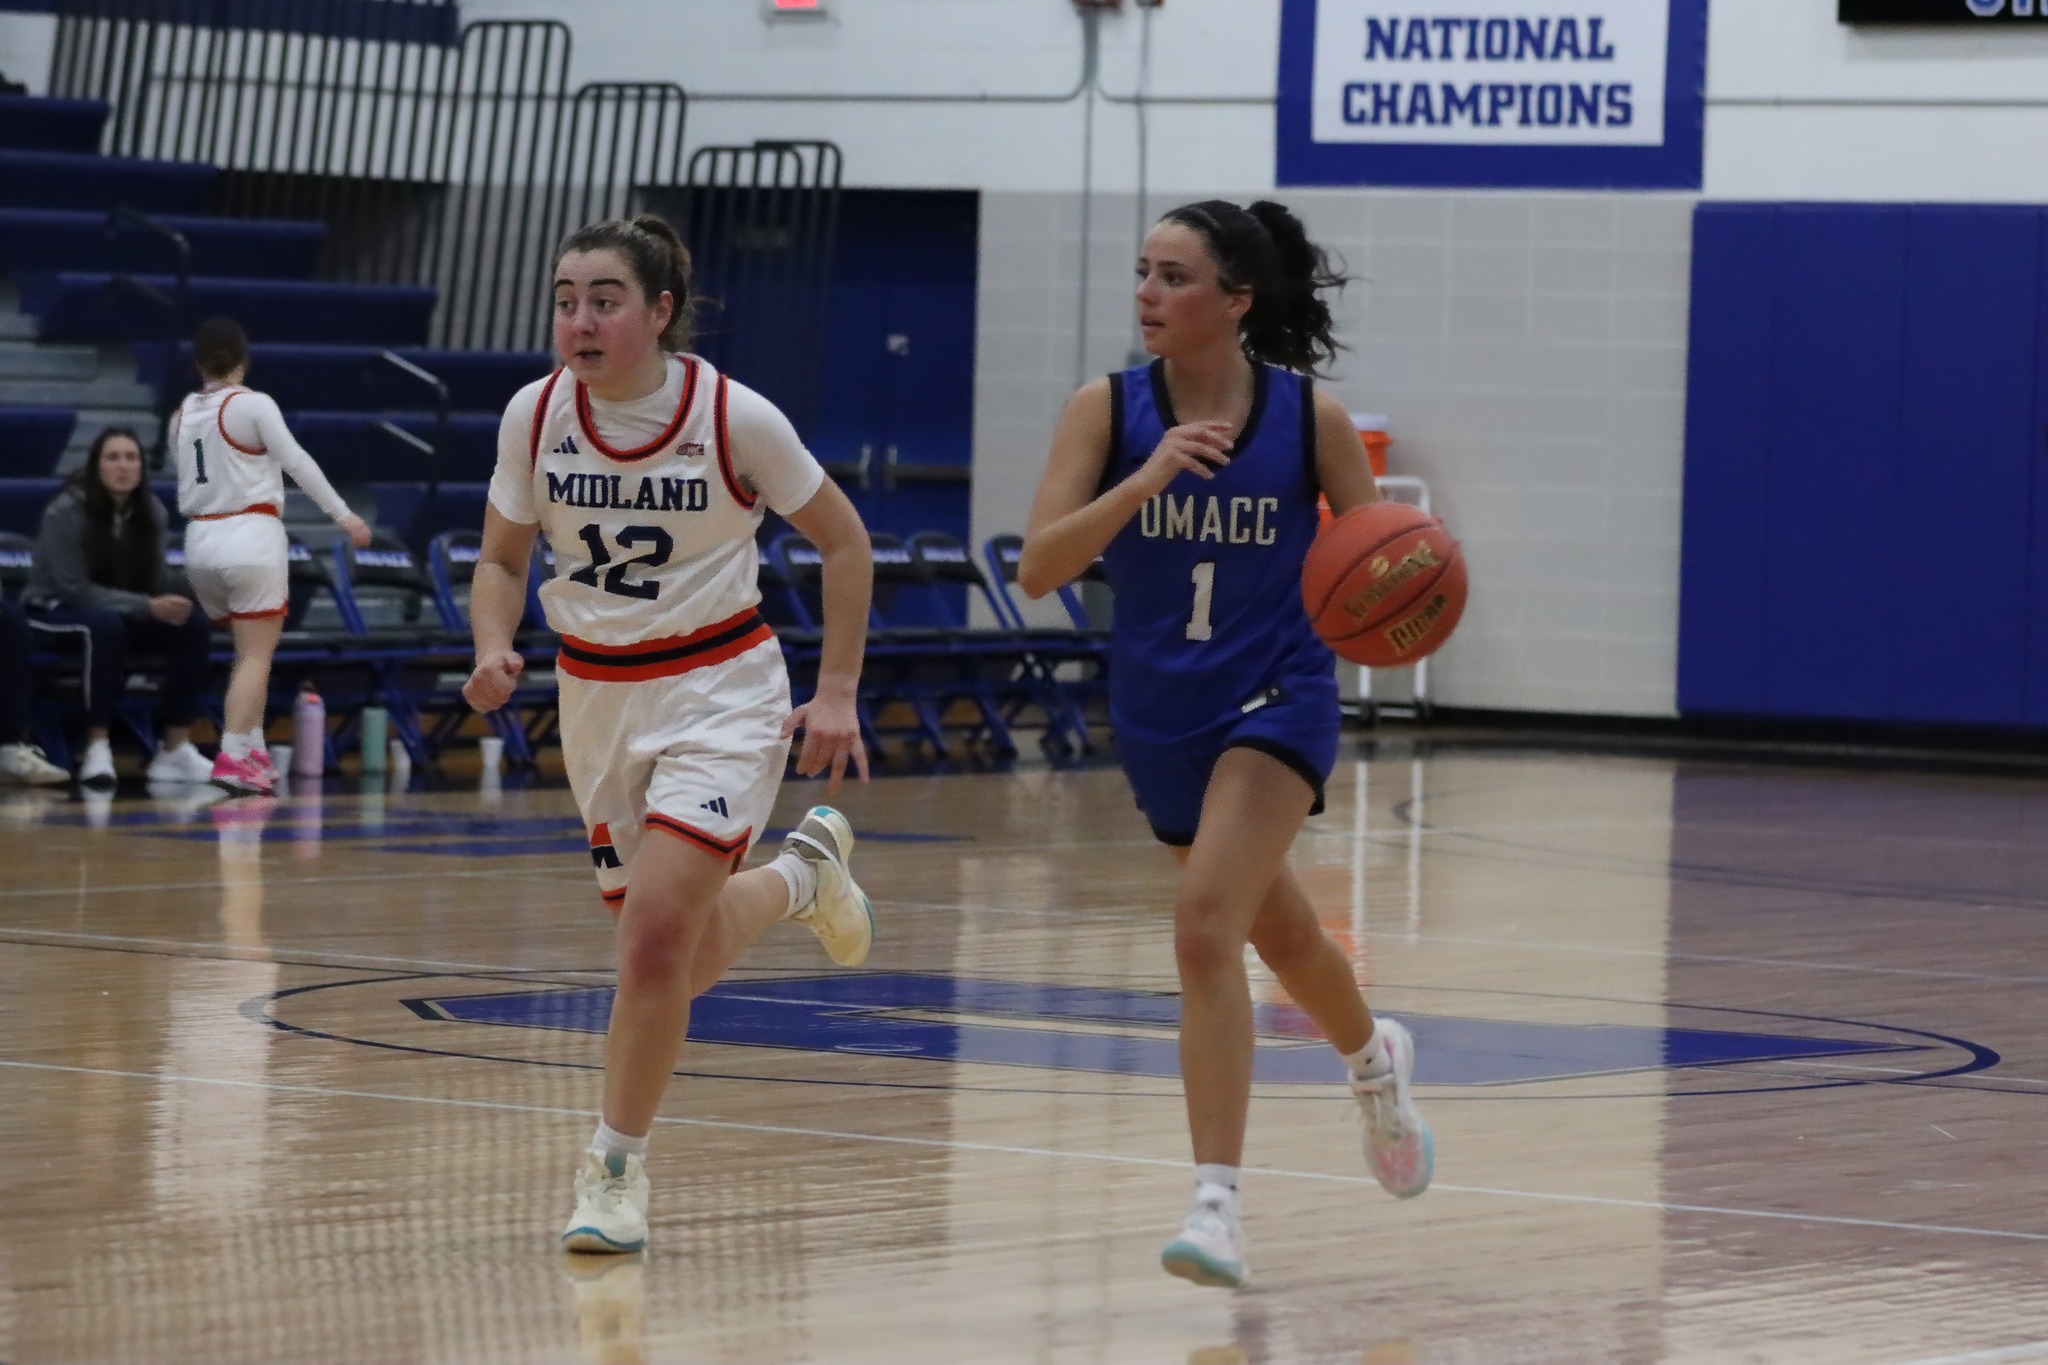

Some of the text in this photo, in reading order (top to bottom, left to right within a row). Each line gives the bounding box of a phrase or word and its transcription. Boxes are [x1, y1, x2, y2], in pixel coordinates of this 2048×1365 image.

[1365, 18, 1615, 61] NATIONAL
[1342, 83, 1632, 127] CHAMPIONS
[193, 438, 209, 485] 1
[546, 472, 708, 512] MIDLAND
[569, 523, 674, 600] 12
[1185, 562, 1215, 642] 1
